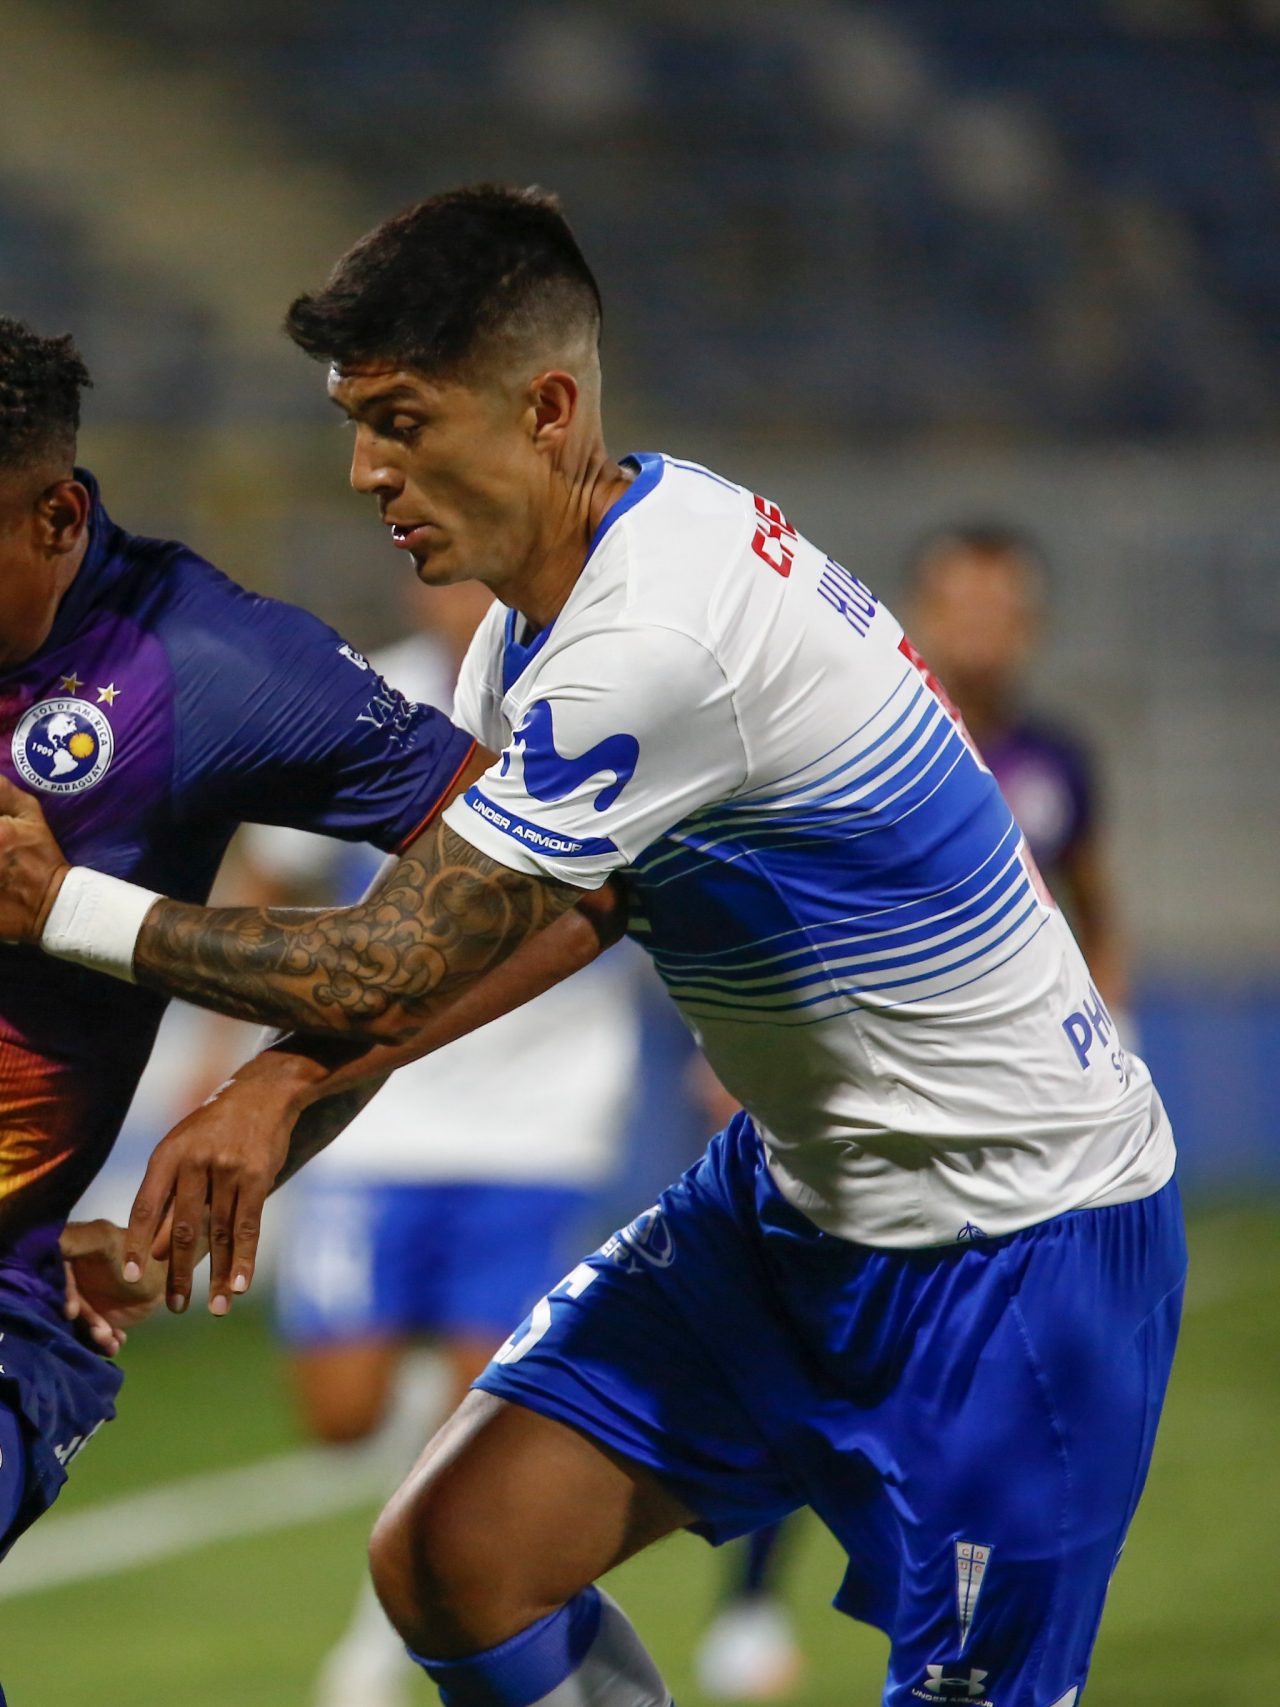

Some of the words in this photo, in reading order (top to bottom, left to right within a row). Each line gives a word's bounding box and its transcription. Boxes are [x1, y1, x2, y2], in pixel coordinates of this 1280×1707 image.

[33, 703, 54, 719] SOL
[57, 702, 71, 711] DE
[74, 704, 109, 747] AMRICA
[16, 733, 43, 786] UNCION
[50, 765, 102, 791] PARAGUAY
[31, 741, 54, 757] 1909
[472, 798, 511, 830] UNDER
